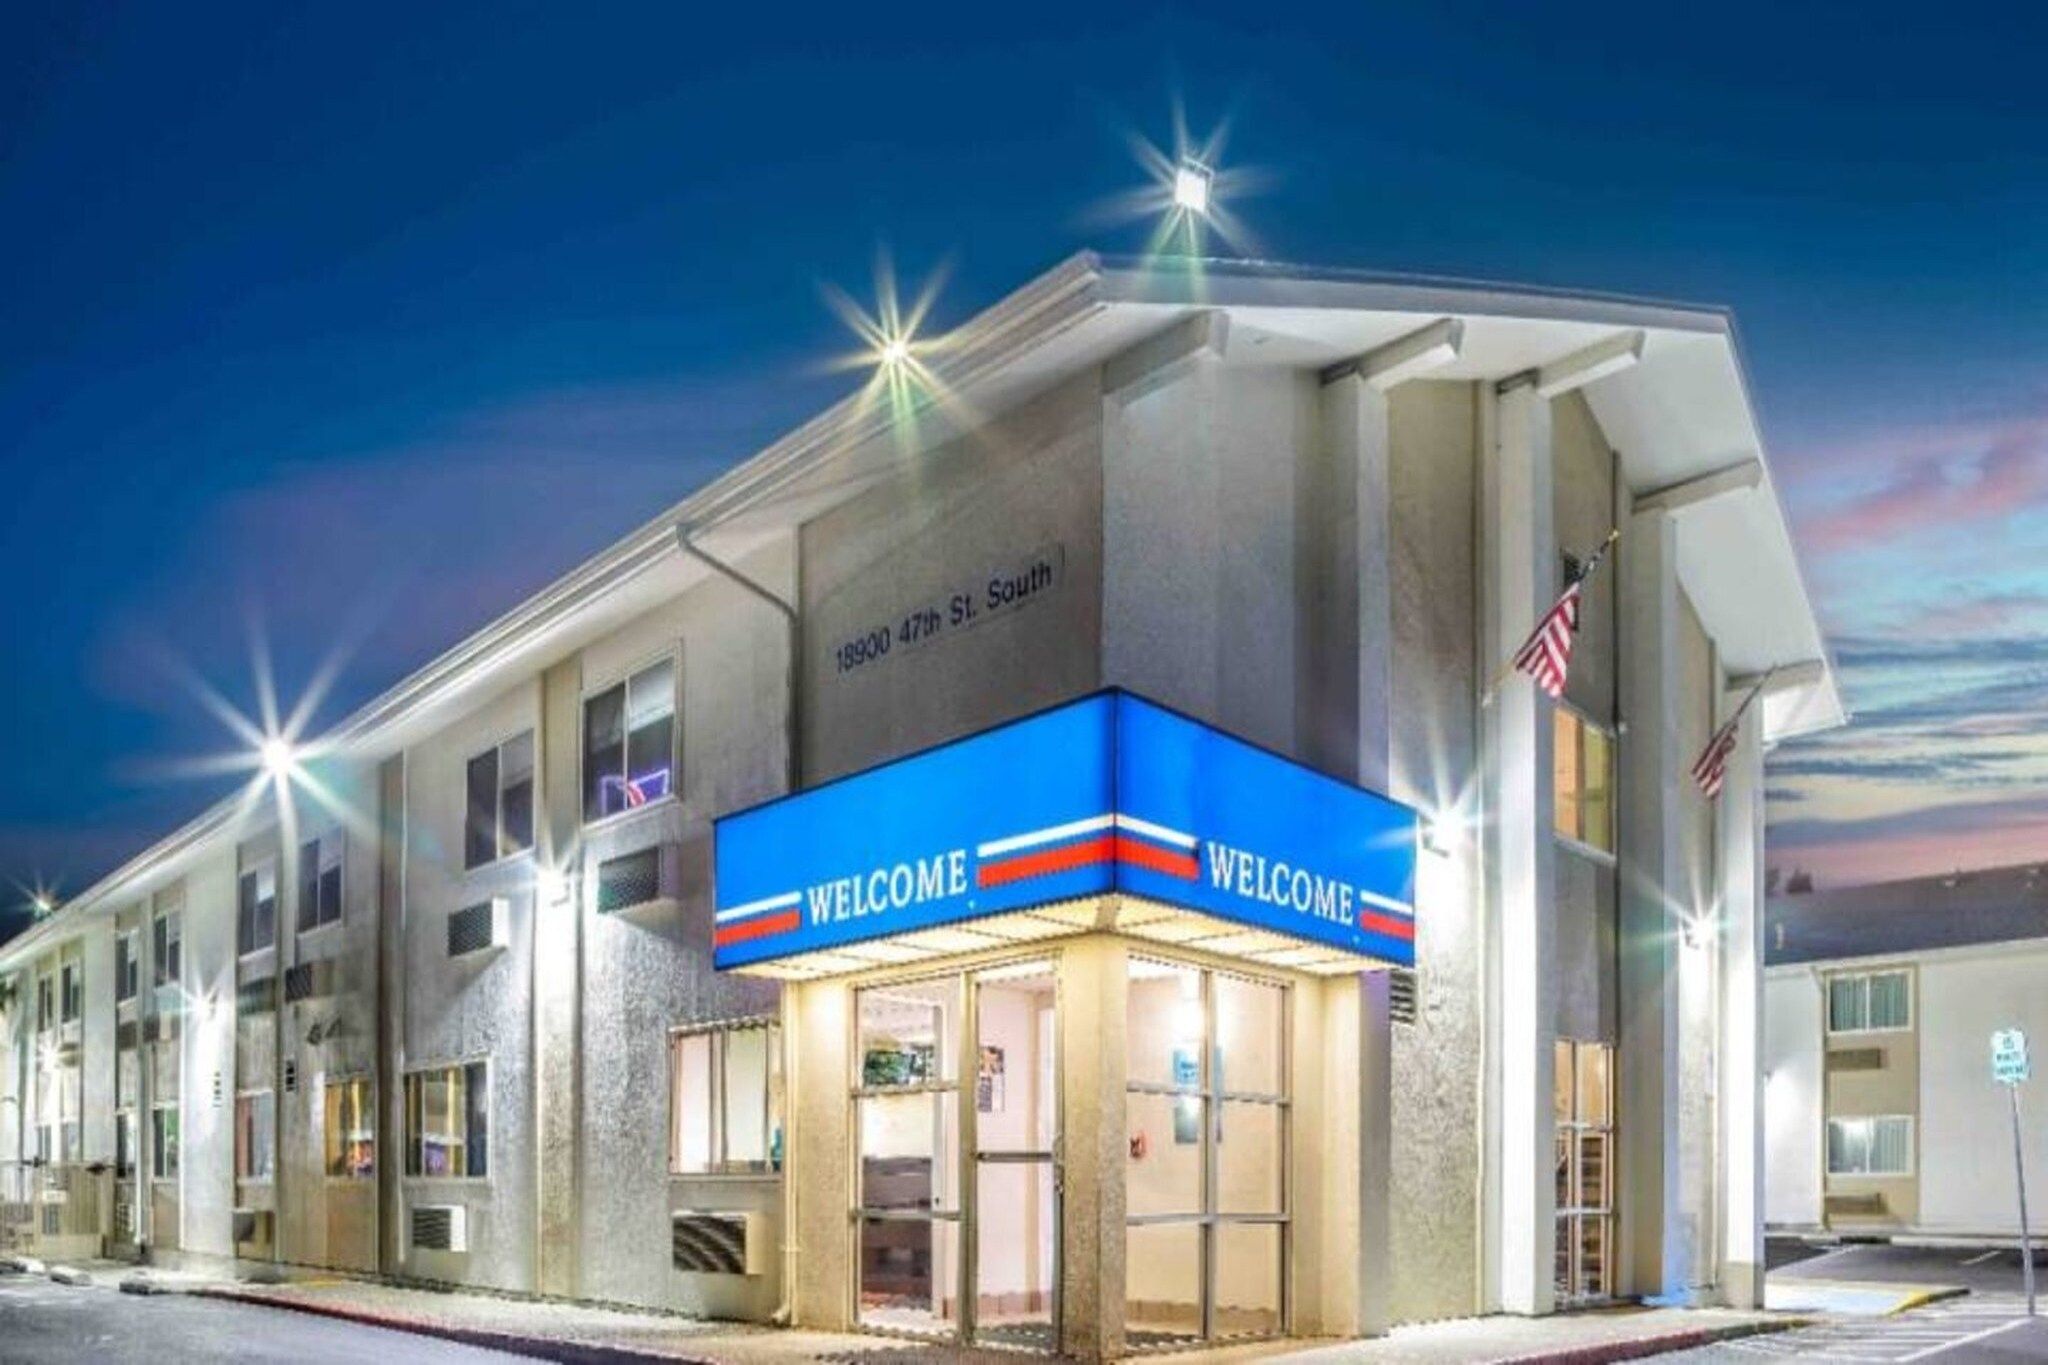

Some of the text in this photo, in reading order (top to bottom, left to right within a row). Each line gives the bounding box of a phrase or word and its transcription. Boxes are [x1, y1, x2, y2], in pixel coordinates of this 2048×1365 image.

[900, 606, 942, 643] 47th
[948, 595, 977, 626] St.
[986, 561, 1052, 610] South
[807, 849, 968, 925] WELCOME
[1207, 841, 1354, 926] WELCOME
